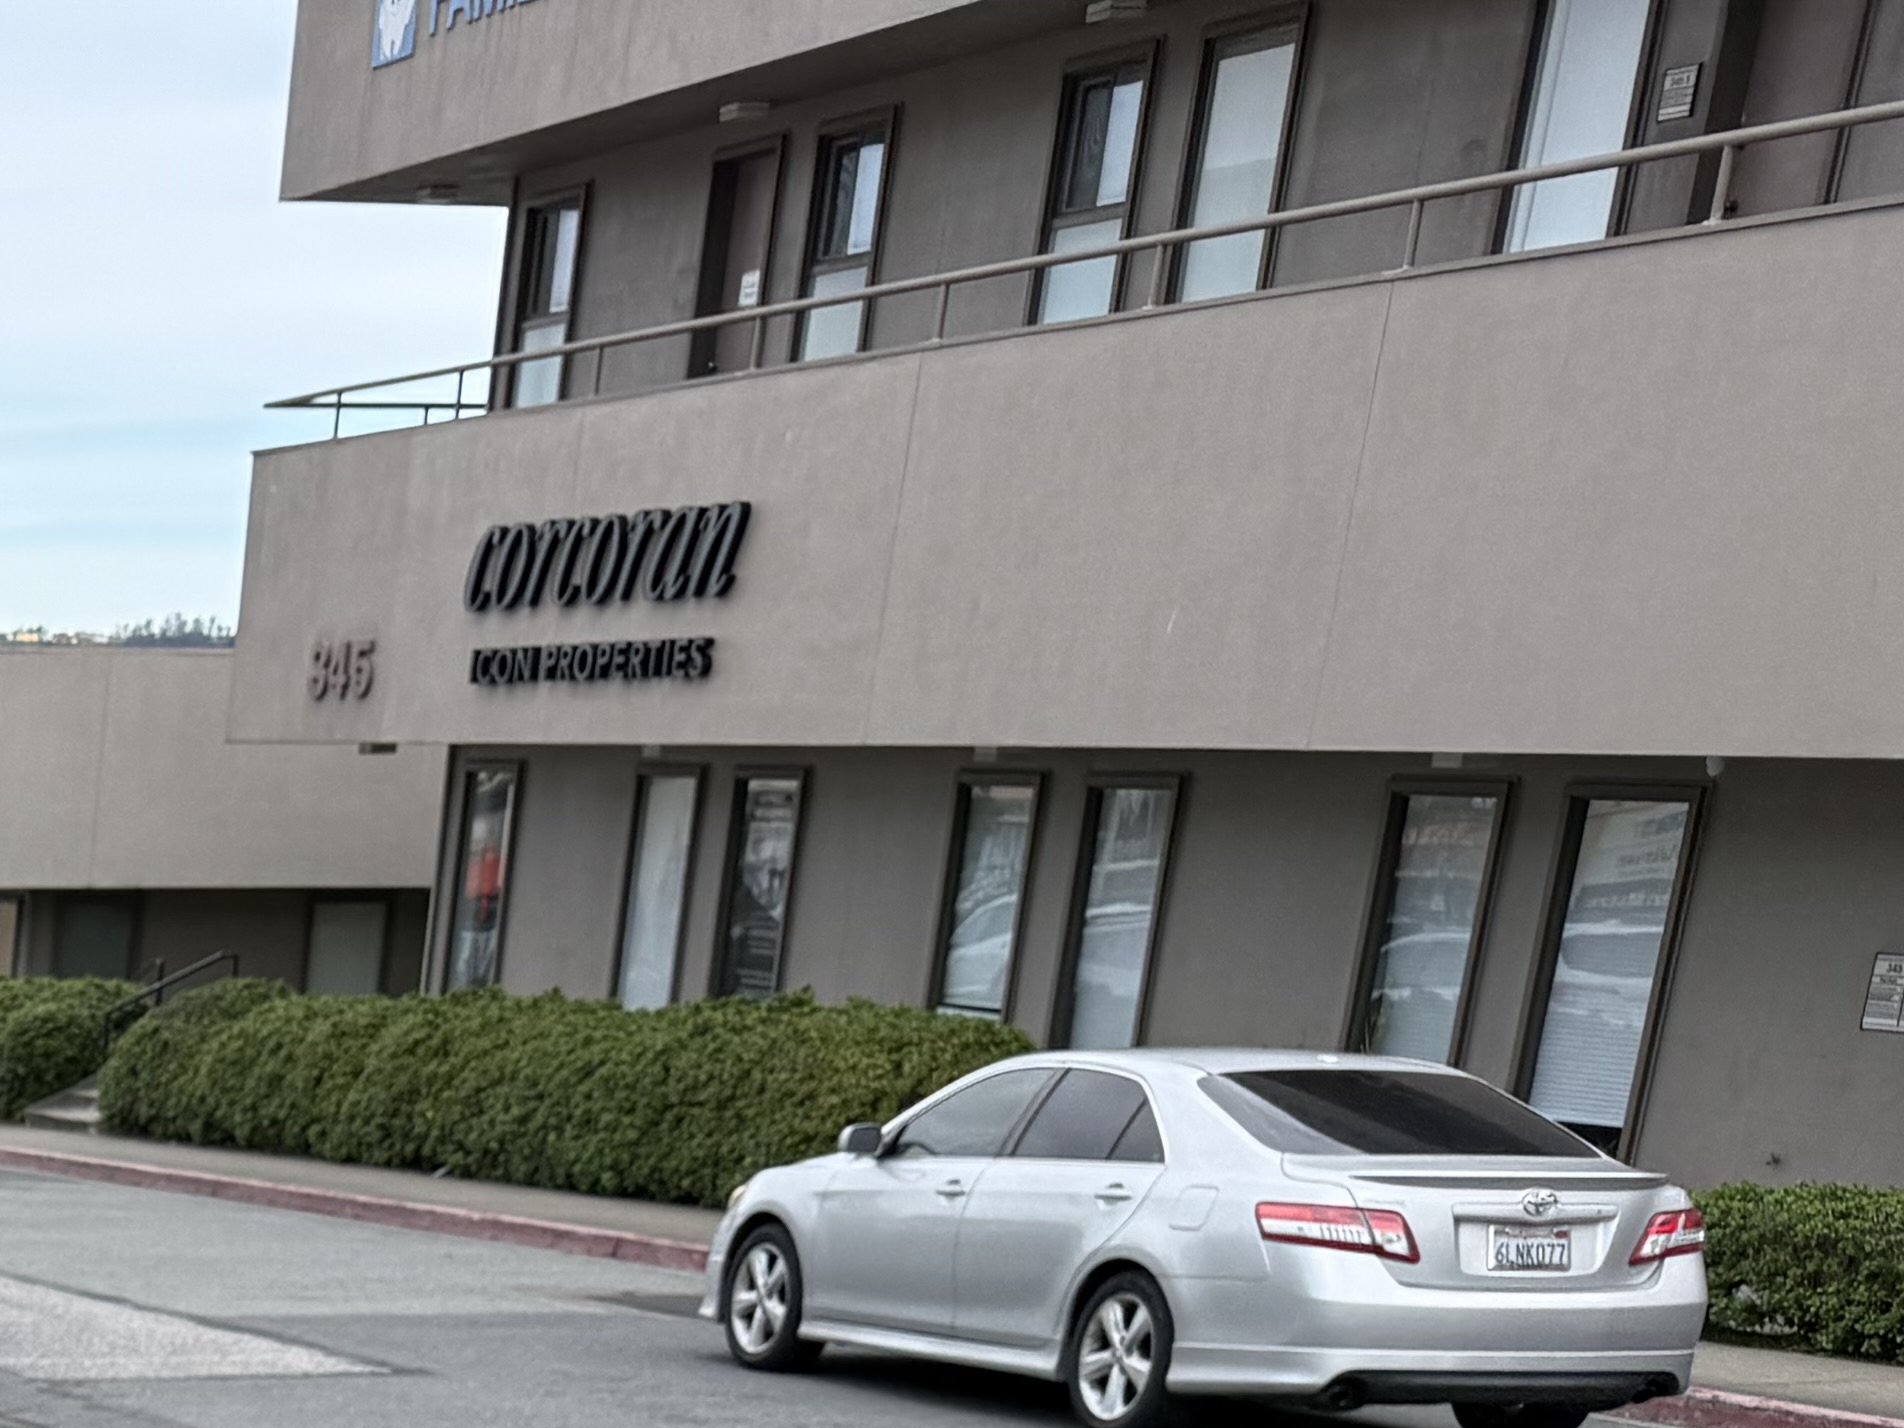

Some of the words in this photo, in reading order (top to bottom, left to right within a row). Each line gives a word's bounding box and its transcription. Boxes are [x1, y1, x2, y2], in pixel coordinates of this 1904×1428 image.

[464, 501, 751, 612] corcoran
[470, 645, 539, 684] ICON
[538, 637, 715, 682] PROPERTIES
